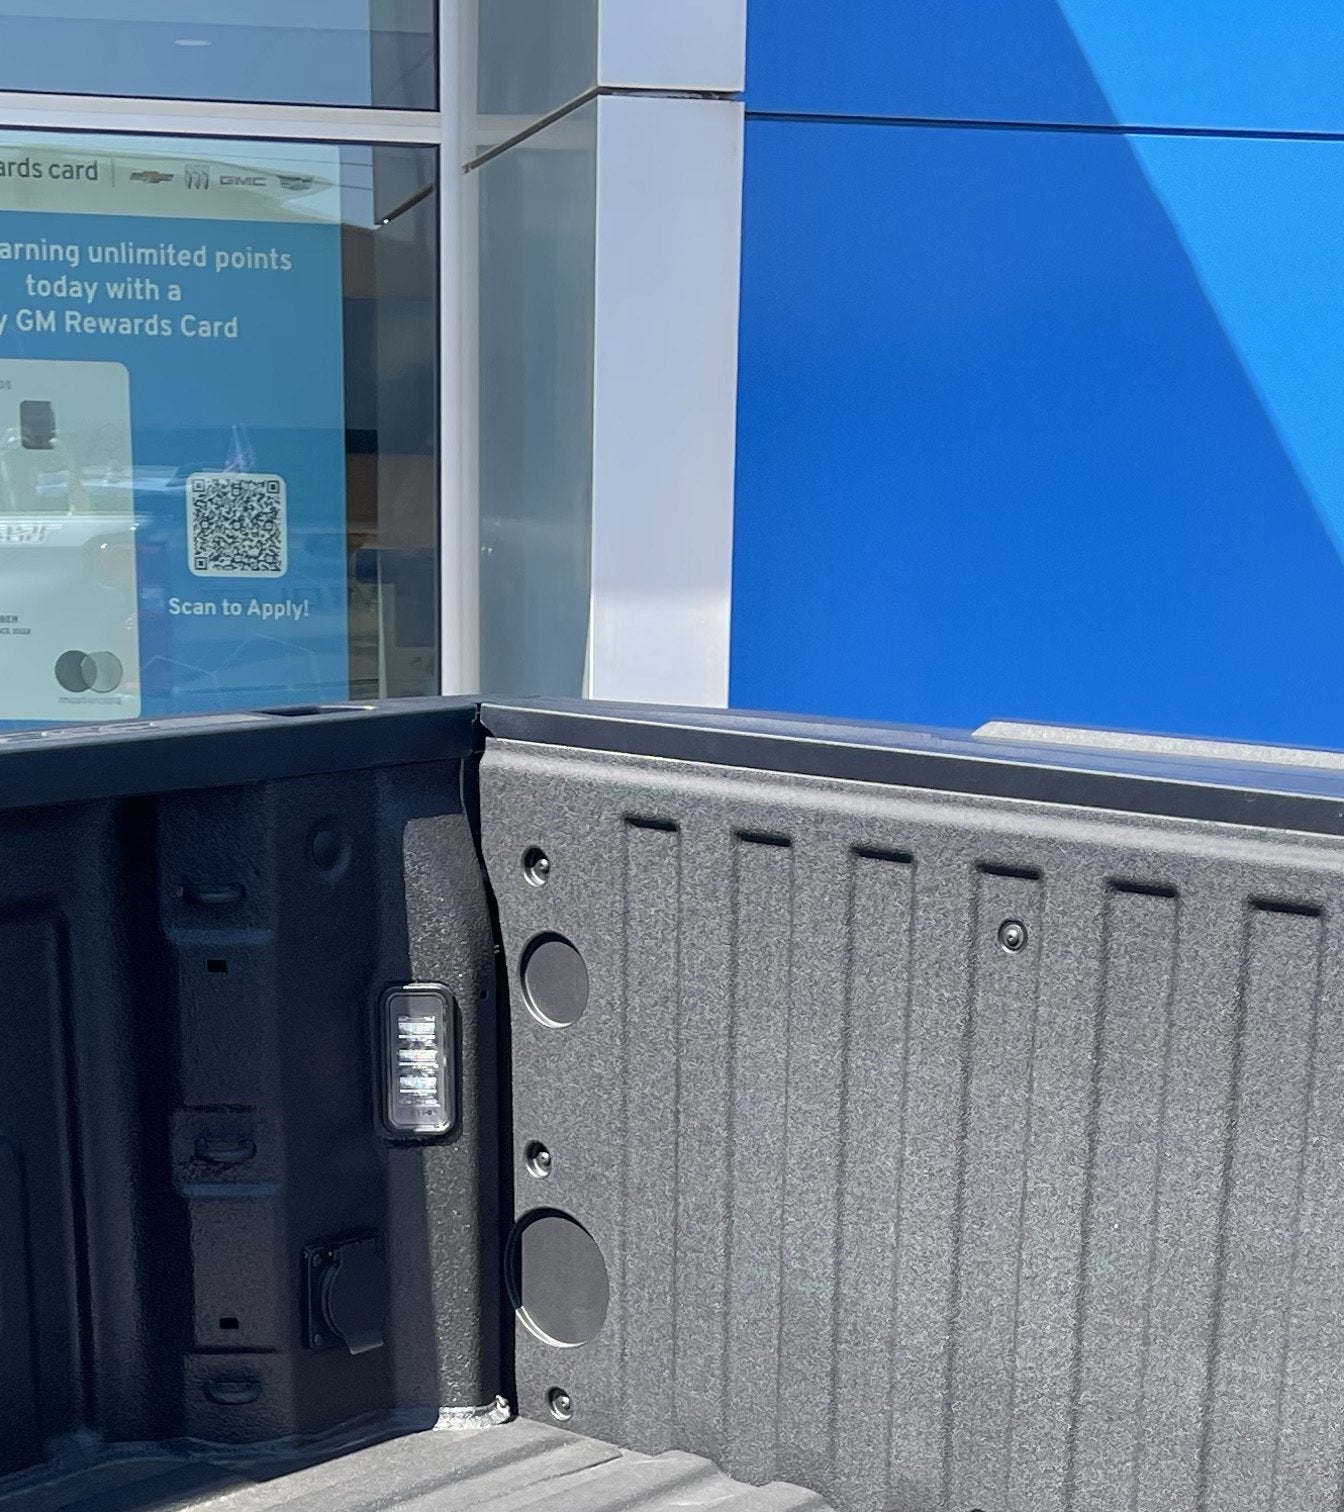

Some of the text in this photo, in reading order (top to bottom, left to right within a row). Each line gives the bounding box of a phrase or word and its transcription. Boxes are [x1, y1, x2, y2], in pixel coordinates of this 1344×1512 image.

[48, 160, 98, 181] card
[219, 174, 267, 186] GMC
[88, 242, 206, 267] unlimited
[215, 247, 292, 272] points
[26, 273, 182, 304] today with a
[16, 309, 56, 332] GM
[65, 310, 172, 337] Rewards
[180, 314, 238, 338] Card
[168, 597, 309, 621] Scan to Apply!
